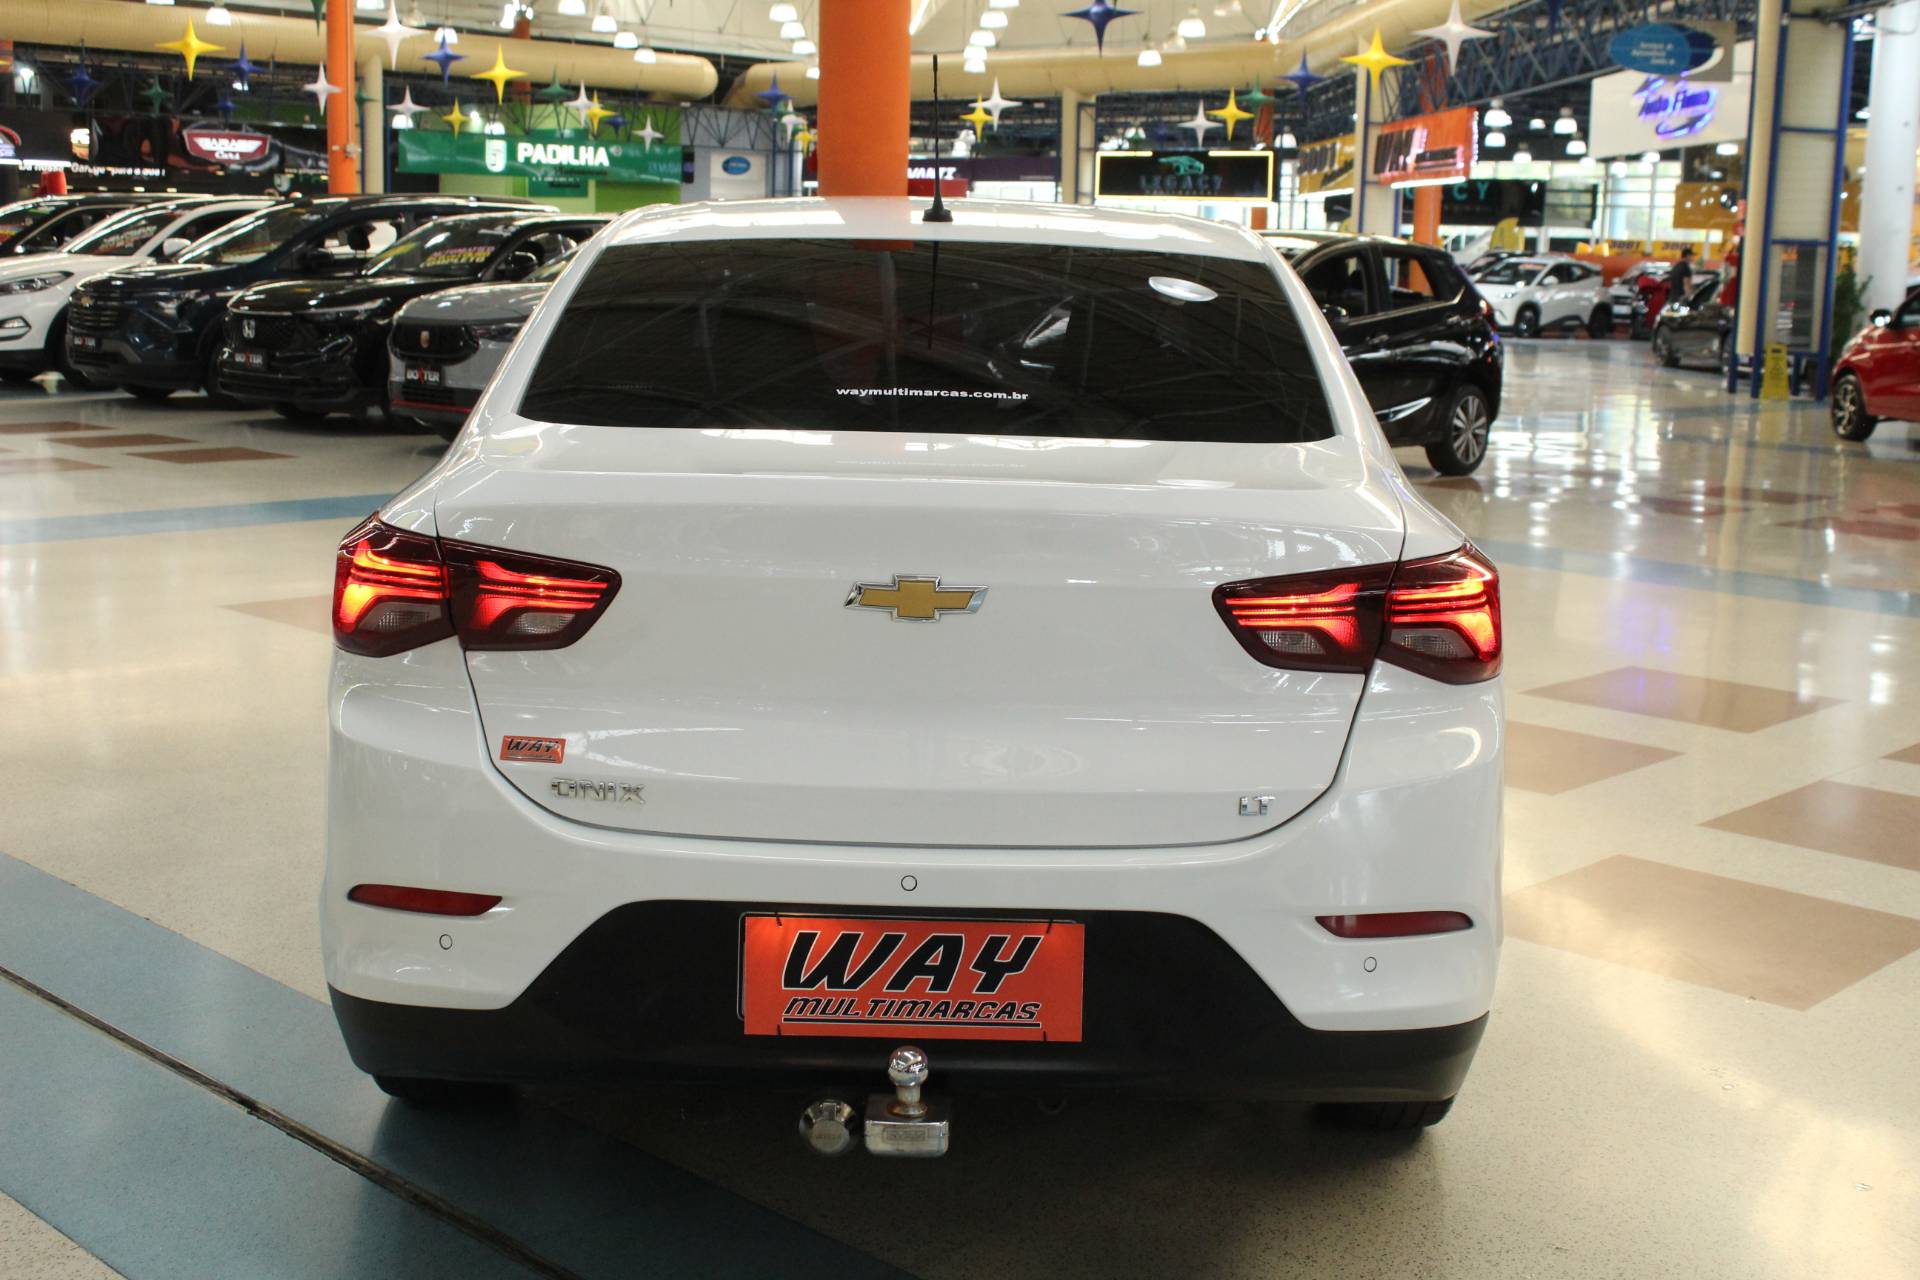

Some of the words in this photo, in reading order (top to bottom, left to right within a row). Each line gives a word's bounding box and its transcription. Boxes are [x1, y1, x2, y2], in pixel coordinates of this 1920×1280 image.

[517, 142, 610, 167] PADILHA
[907, 166, 957, 180] VANTI
[1140, 175, 1223, 191] LEGACY
[836, 387, 1029, 400] waymultimarcas.com.br
[507, 739, 560, 753] WAY
[551, 777, 646, 804] ONIX
[1239, 796, 1276, 816] LT
[782, 930, 1044, 994] WAY
[783, 997, 1042, 1020] MULTIMARCAS
